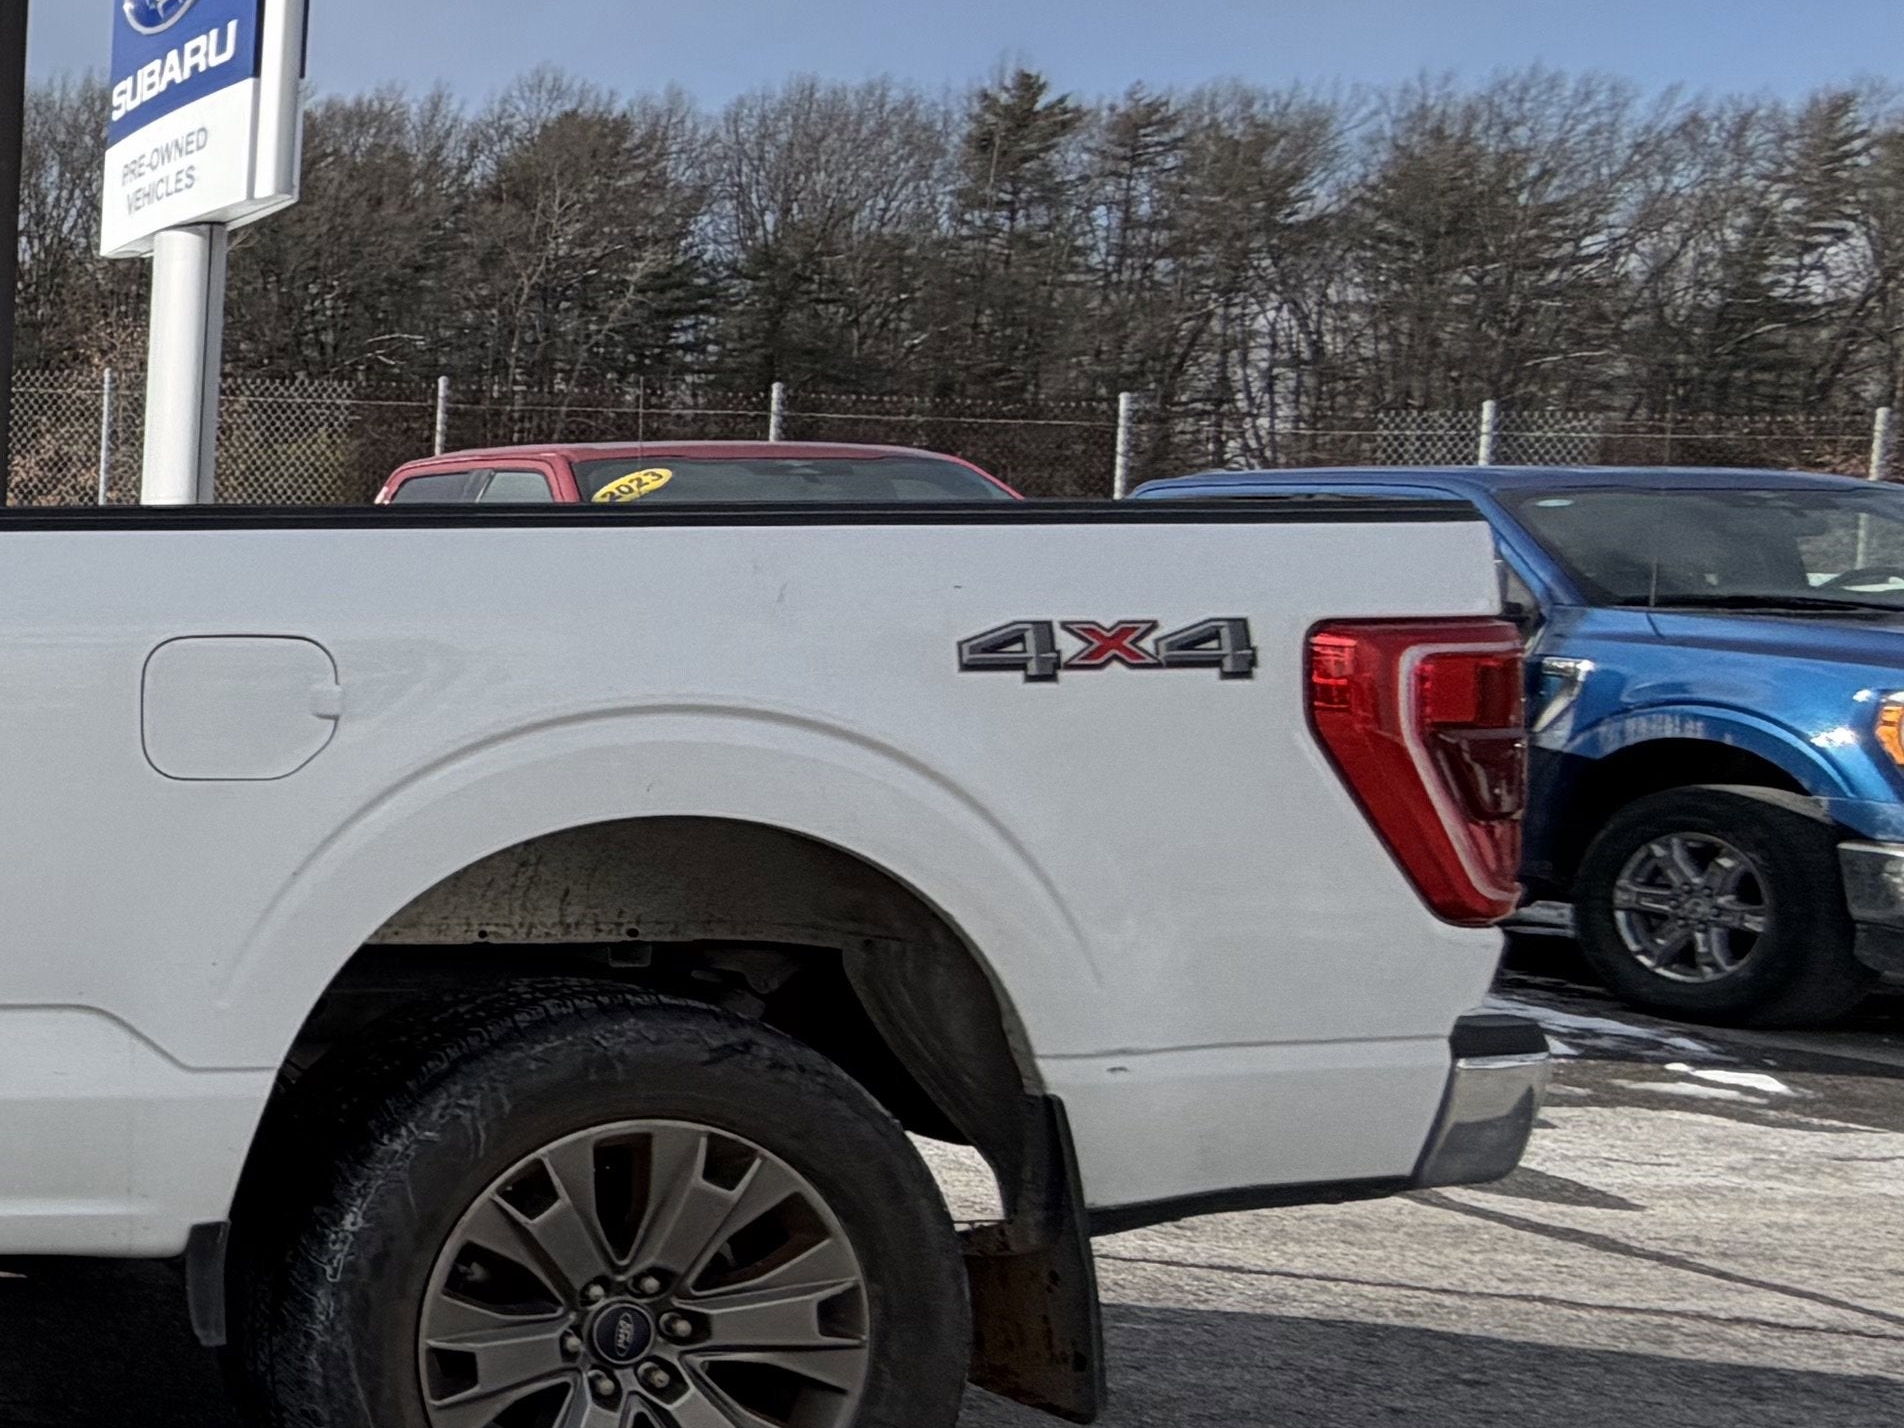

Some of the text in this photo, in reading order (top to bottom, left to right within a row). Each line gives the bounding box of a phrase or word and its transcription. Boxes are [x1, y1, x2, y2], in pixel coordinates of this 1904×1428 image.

[111, 20, 238, 122] SUBARU
[122, 127, 209, 187] PRE-OWNED
[127, 166, 196, 215] VEHICLES
[600, 471, 663, 502] 2023
